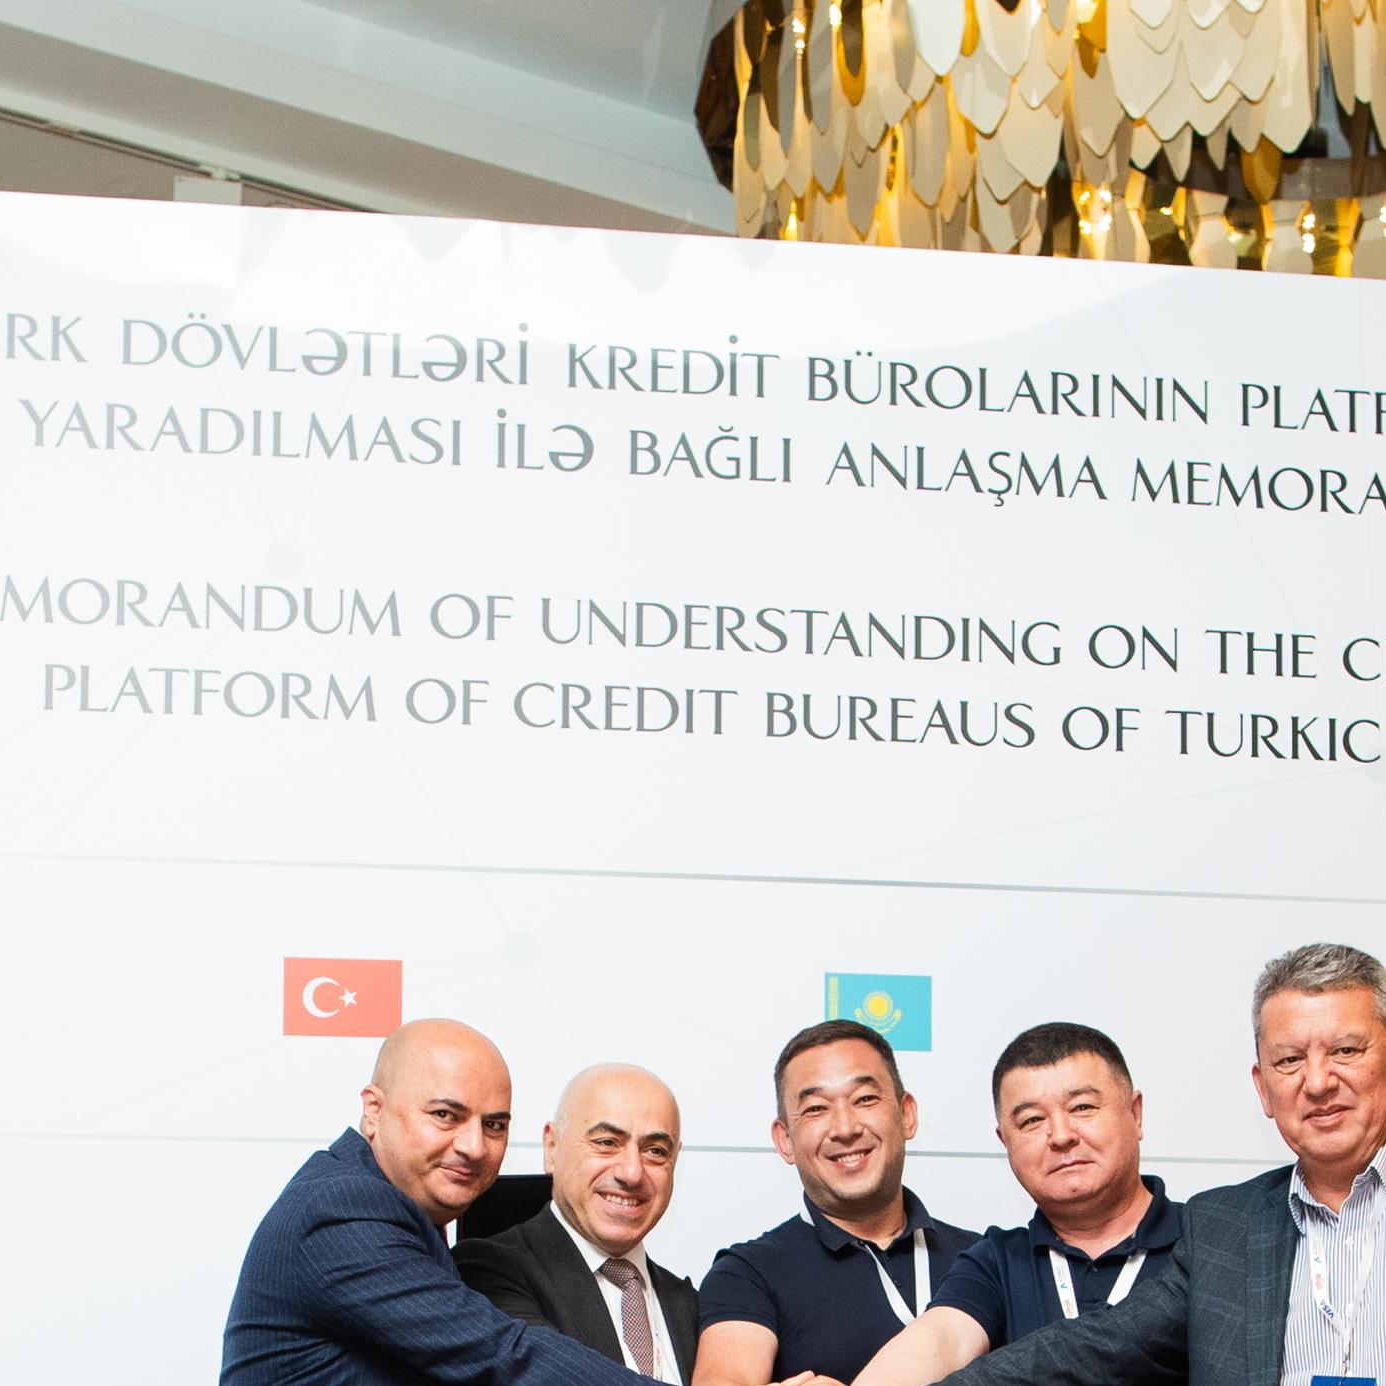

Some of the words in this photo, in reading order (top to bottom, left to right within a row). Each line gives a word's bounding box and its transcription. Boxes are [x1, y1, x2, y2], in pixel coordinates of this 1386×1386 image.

[122, 313, 528, 385] DÖVLƏTLƏRİ
[567, 334, 781, 398] KREDİT
[807, 350, 1208, 425] BÜROLARININ
[18, 399, 461, 466] YARADILMASI
[496, 408, 594, 472] İLƏ
[629, 425, 792, 483] BAĞLI
[825, 441, 1109, 507] ANLAŞMA
[430, 593, 514, 641] OF
[541, 598, 1061, 666] UNDERSTANDING
[1088, 624, 1178, 673] ON
[1204, 629, 1318, 679] THE
[44, 664, 377, 722] PLATFORM
[405, 678, 490, 725] OF
[513, 682, 739, 735] CREDIT
[765, 692, 1035, 748] BUREAUS
[1062, 706, 1141, 752] OF
[1164, 710, 1381, 763] TURKIC
